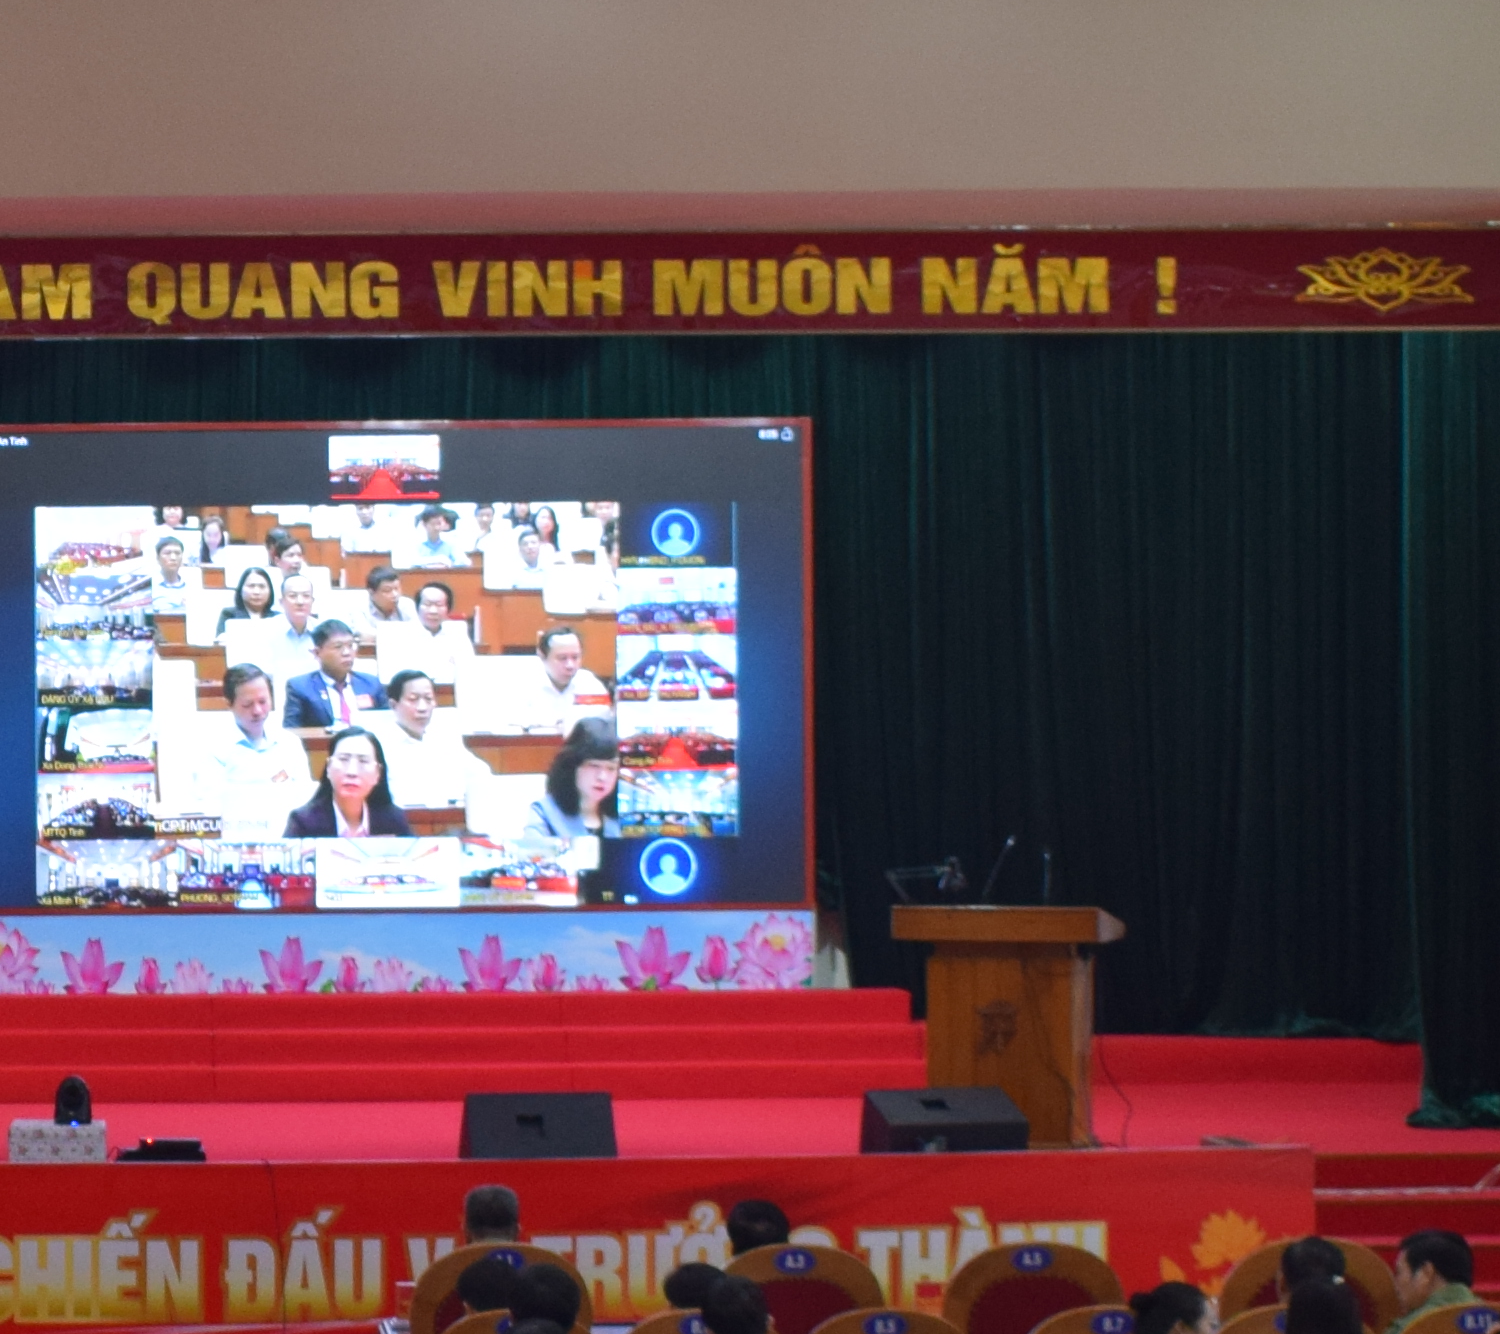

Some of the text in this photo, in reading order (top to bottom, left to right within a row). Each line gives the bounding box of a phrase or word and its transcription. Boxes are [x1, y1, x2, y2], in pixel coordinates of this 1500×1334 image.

[127, 260, 400, 326] QUANG
[431, 259, 622, 319] VINH
[652, 244, 892, 317] MUÔN
[922, 243, 1109, 315] NĂM
[1156, 258, 1175, 315] !
[223, 1206, 385, 1323] ĐẤU
